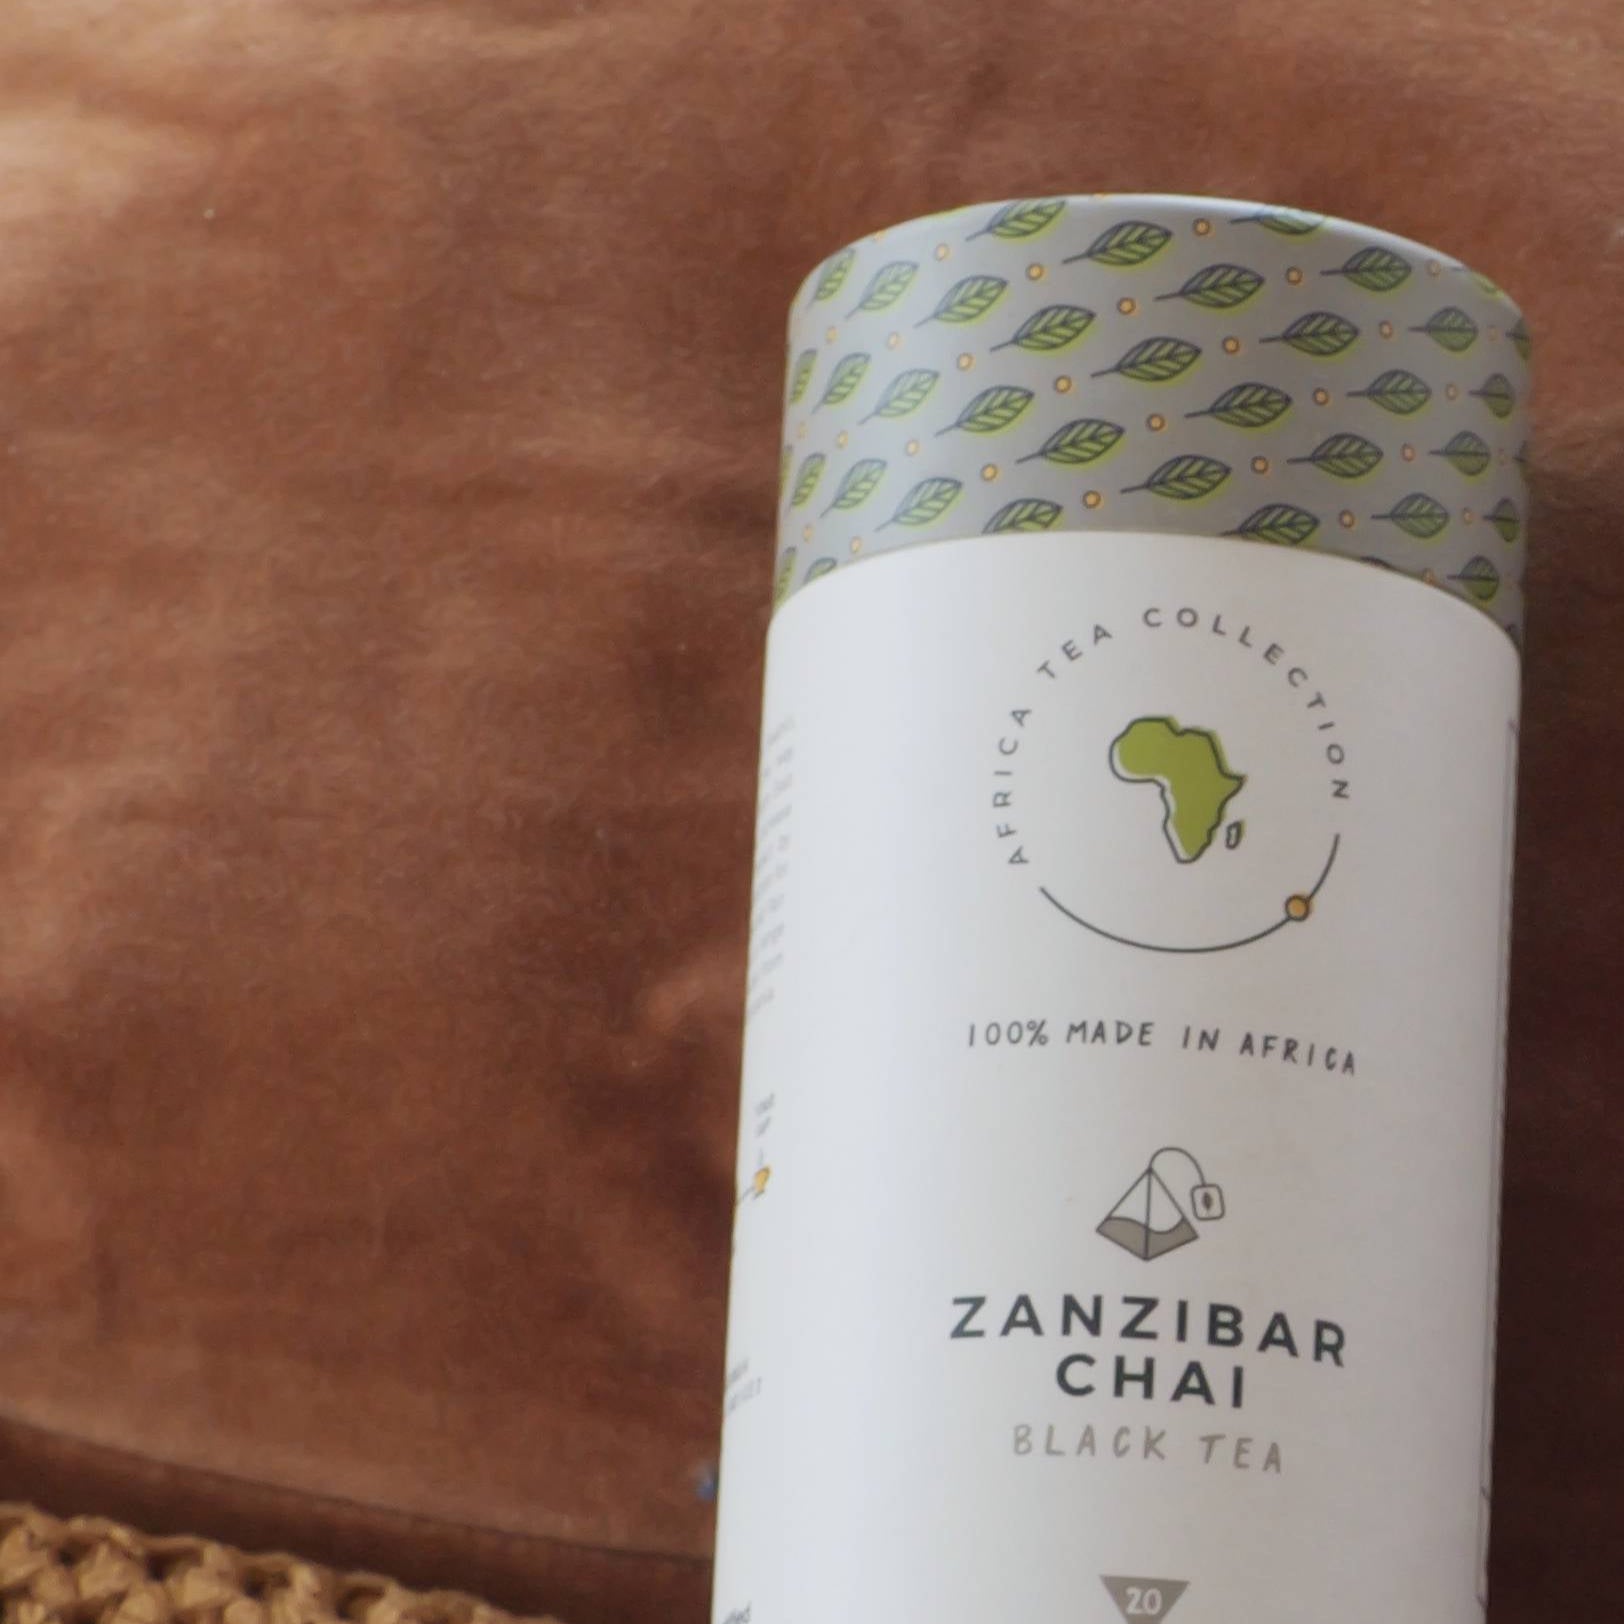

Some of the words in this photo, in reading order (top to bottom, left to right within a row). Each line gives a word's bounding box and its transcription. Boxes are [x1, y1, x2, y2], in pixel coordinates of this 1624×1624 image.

[992, 706, 1032, 867] AFRICA
[1037, 623, 1112, 681] TEA
[1142, 606, 1350, 800] COLLECTION
[968, 1018, 1049, 1047] 100%
[1065, 1019, 1155, 1047] MADE
[1182, 1025, 1221, 1052] IN
[1239, 1032, 1356, 1077] AFRICA
[949, 1293, 1346, 1368] ZANZIBAR
[1055, 1353, 1244, 1409] CHAI
[1012, 1423, 1167, 1461] BLACK
[1199, 1433, 1283, 1475] TEA
[1125, 1586, 1163, 1616] 20
